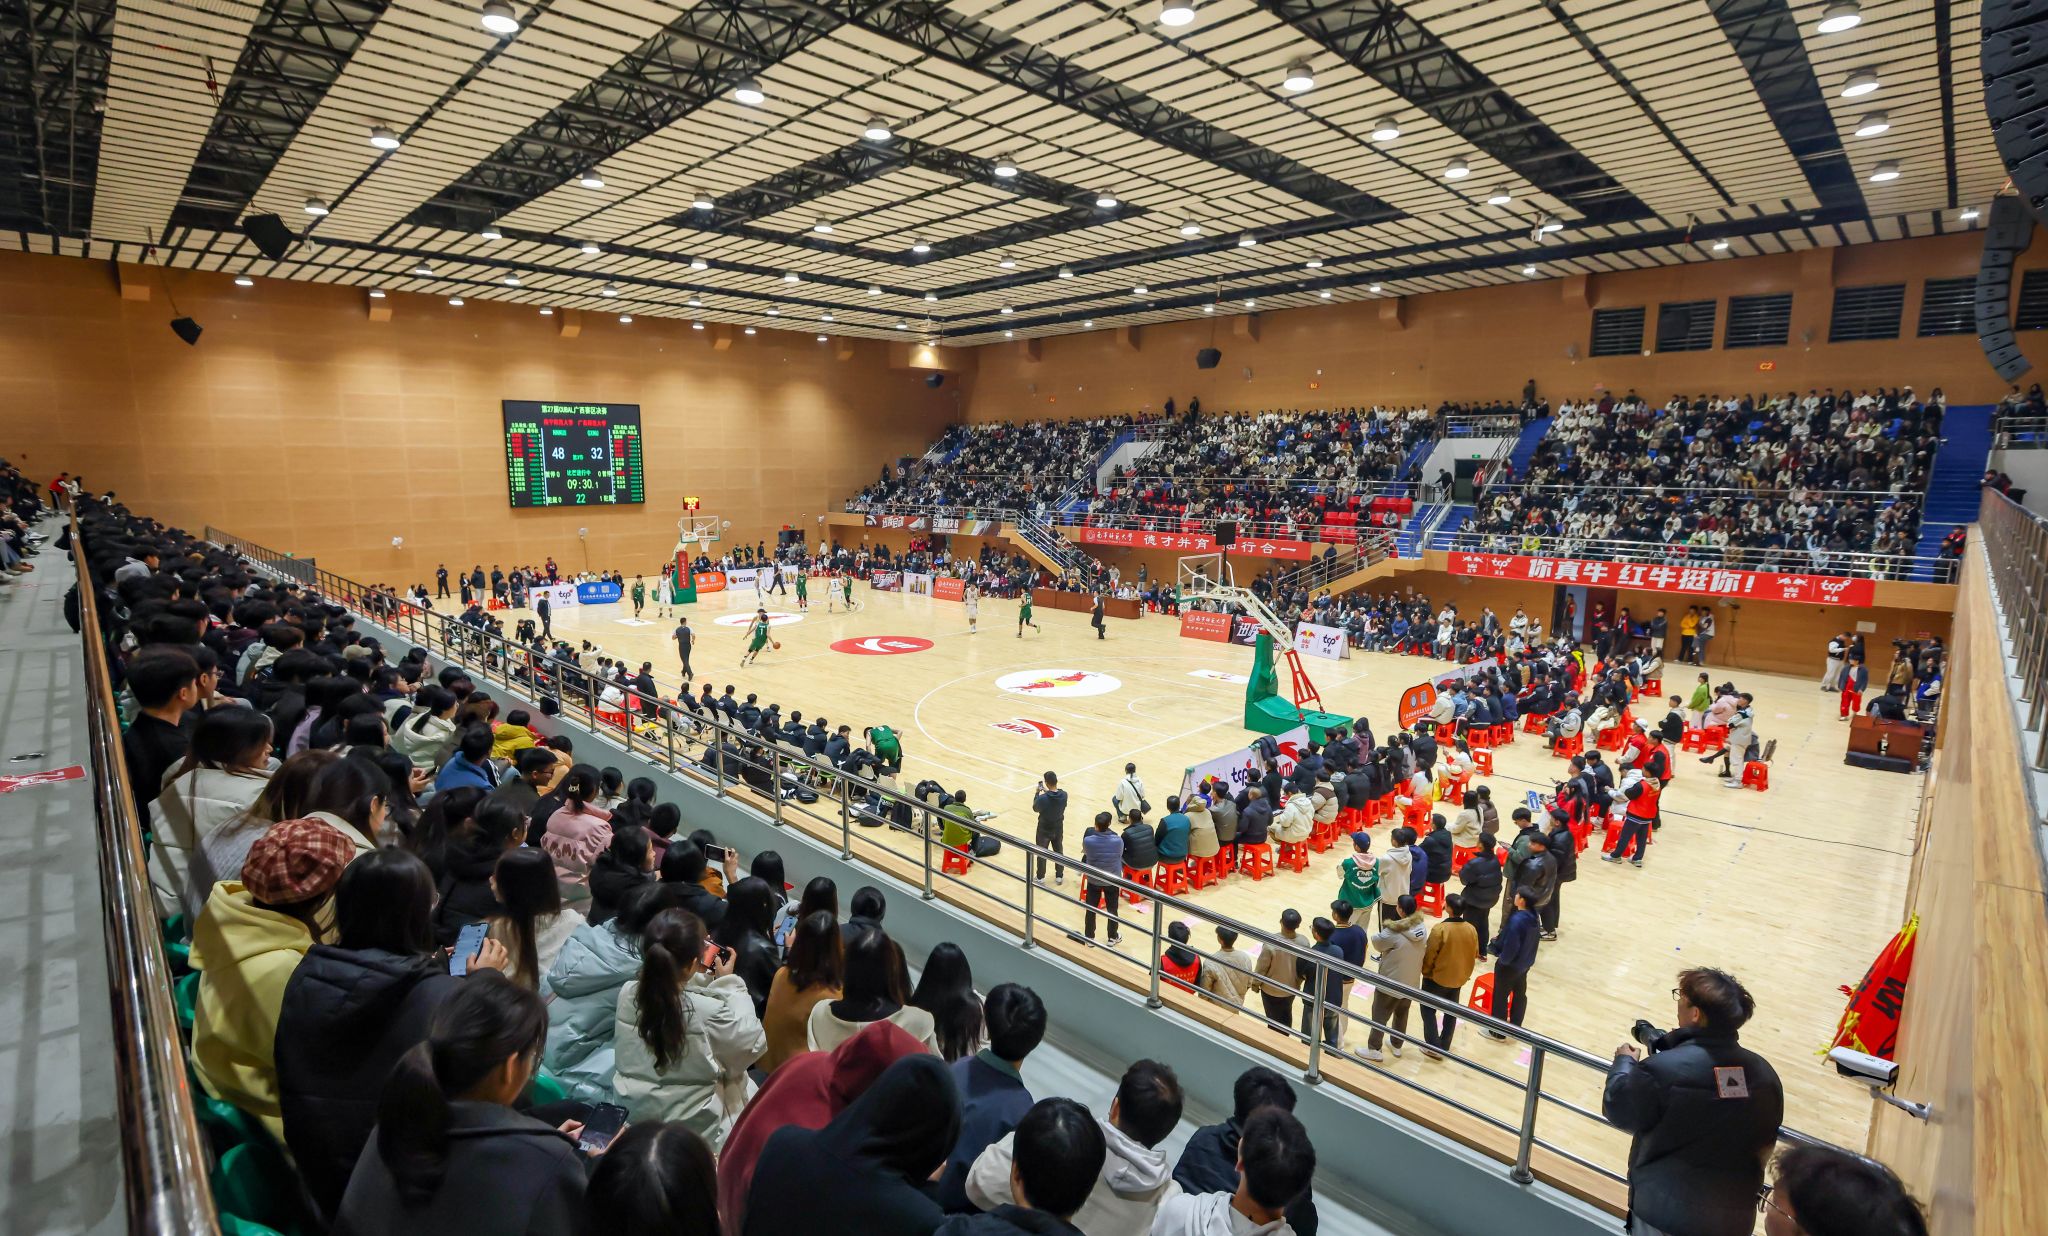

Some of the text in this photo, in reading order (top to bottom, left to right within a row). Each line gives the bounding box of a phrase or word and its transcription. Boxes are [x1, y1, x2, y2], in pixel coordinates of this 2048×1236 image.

[551, 447, 565, 460] 48
[590, 447, 603, 460] 32
[575, 493, 586, 504] 22
[1143, 534, 1209, 550] 德才并育
[1491, 556, 1508, 570] tcp
[1528, 558, 1608, 583] 你真牛
[1821, 580, 1845, 595] tcp
[1323, 634, 1336, 647] tcp
